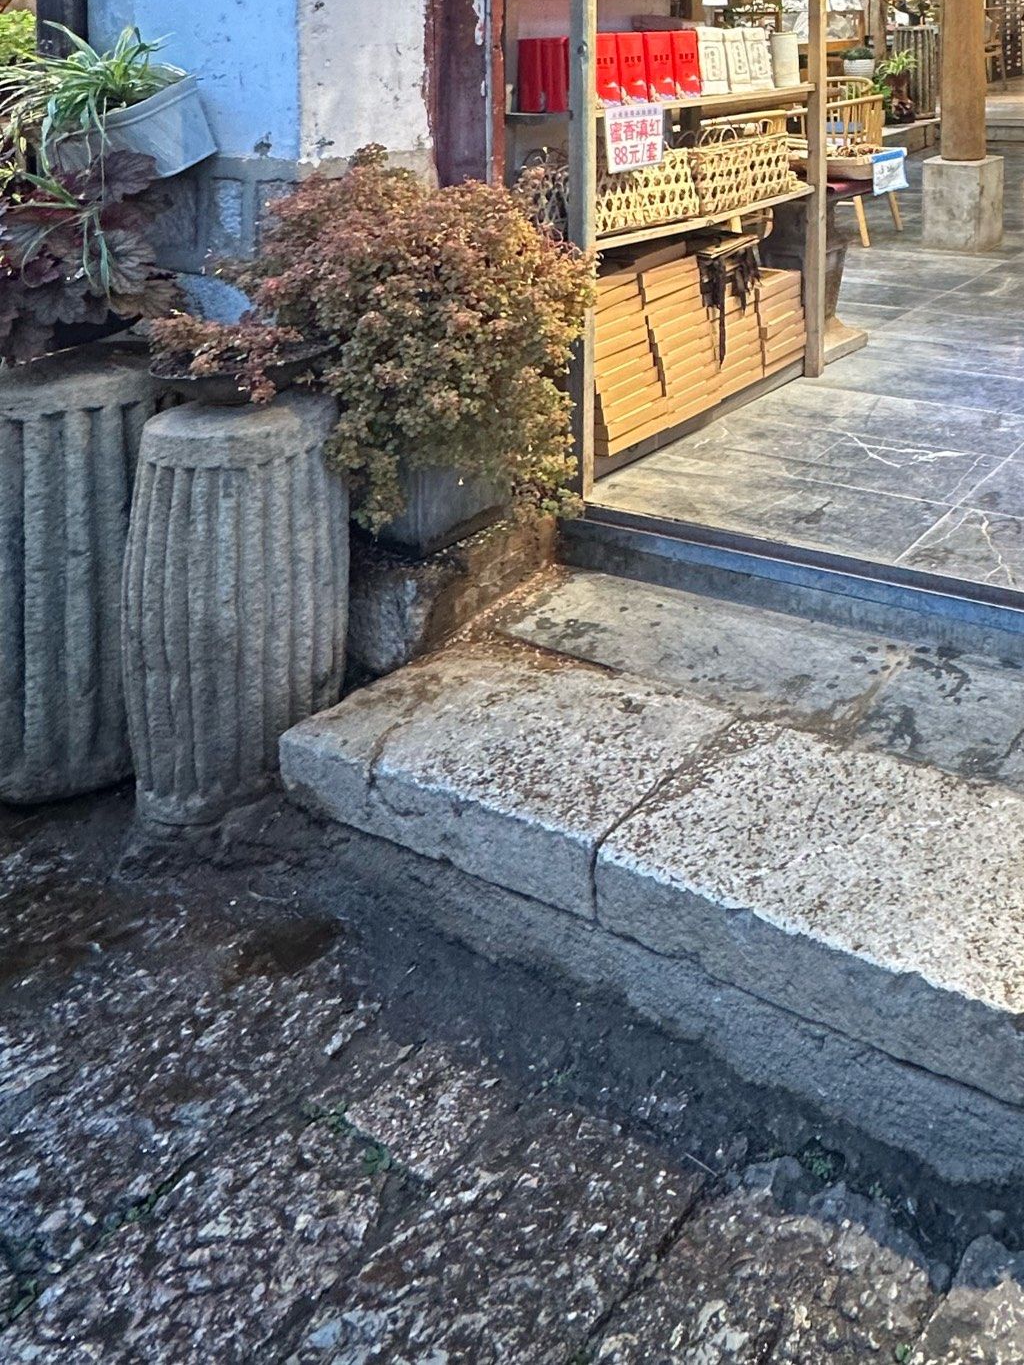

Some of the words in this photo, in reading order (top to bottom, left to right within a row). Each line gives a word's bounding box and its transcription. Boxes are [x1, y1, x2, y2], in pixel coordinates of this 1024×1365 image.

[609, 118, 661, 143] 蜜香滇红
[614, 141, 658, 166] 88元/套
